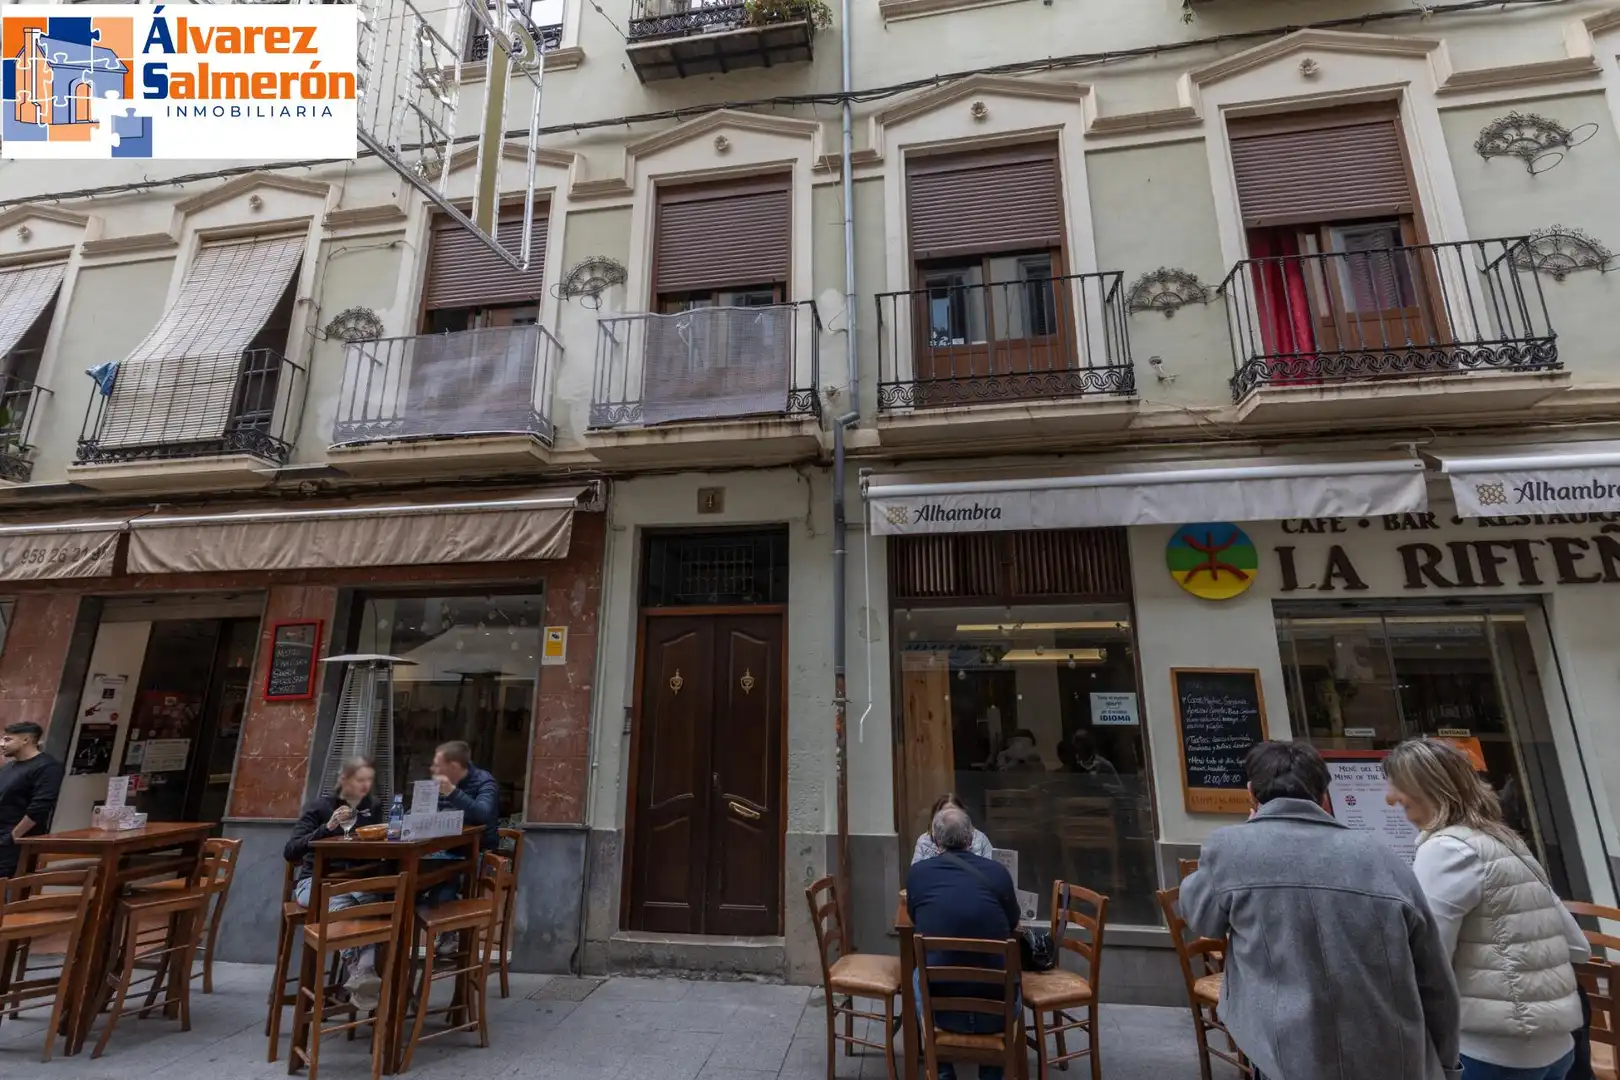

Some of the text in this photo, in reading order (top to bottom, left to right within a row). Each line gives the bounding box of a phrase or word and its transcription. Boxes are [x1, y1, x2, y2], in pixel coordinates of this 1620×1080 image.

[913, 503, 1002, 524] Alhambra
[1383, 511, 1440, 531] BAR
[21, 548, 46, 565] 958
[48, 547, 68, 563] 26
[1274, 545, 1369, 591] LA
